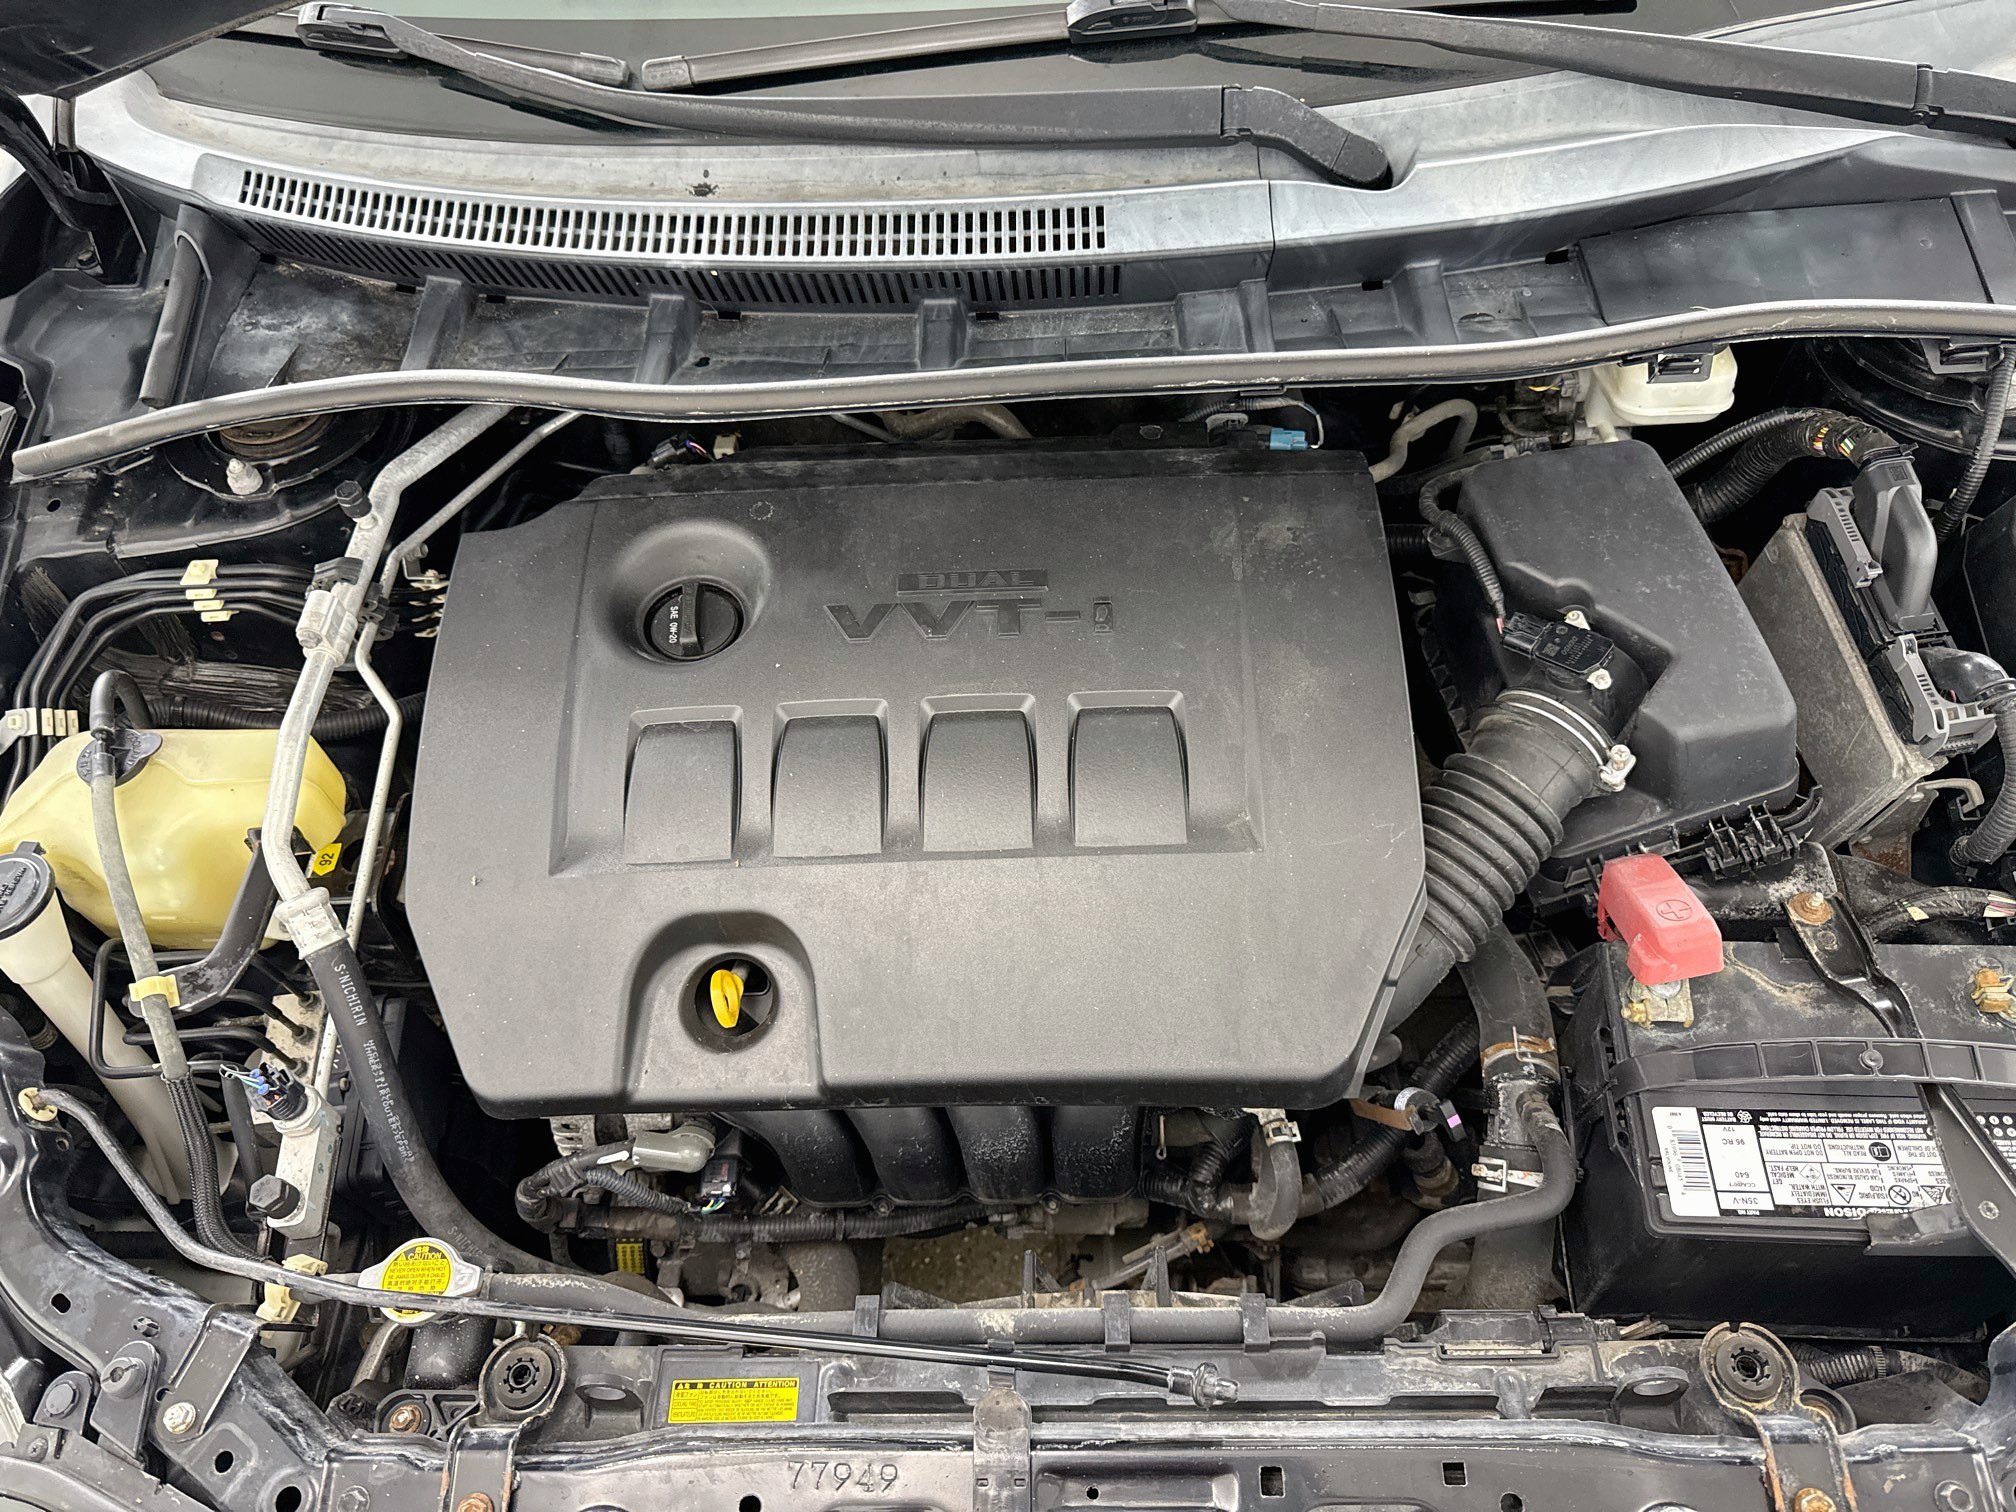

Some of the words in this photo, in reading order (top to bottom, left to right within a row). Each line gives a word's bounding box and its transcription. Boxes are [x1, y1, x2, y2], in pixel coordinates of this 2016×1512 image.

[918, 571, 1035, 589] DUAL
[670, 605, 679, 619] SAE
[823, 596, 1113, 643] VVT-i
[668, 622, 678, 644] 0W-20
[319, 853, 335, 866] 92
[1732, 1197, 1758, 1205] 35N-V
[407, 1252, 442, 1260] CAUTION
[709, 1381, 748, 1389] CAUTION
[753, 1380, 796, 1388] ATTENTION
[787, 1459, 899, 1493] 77949
